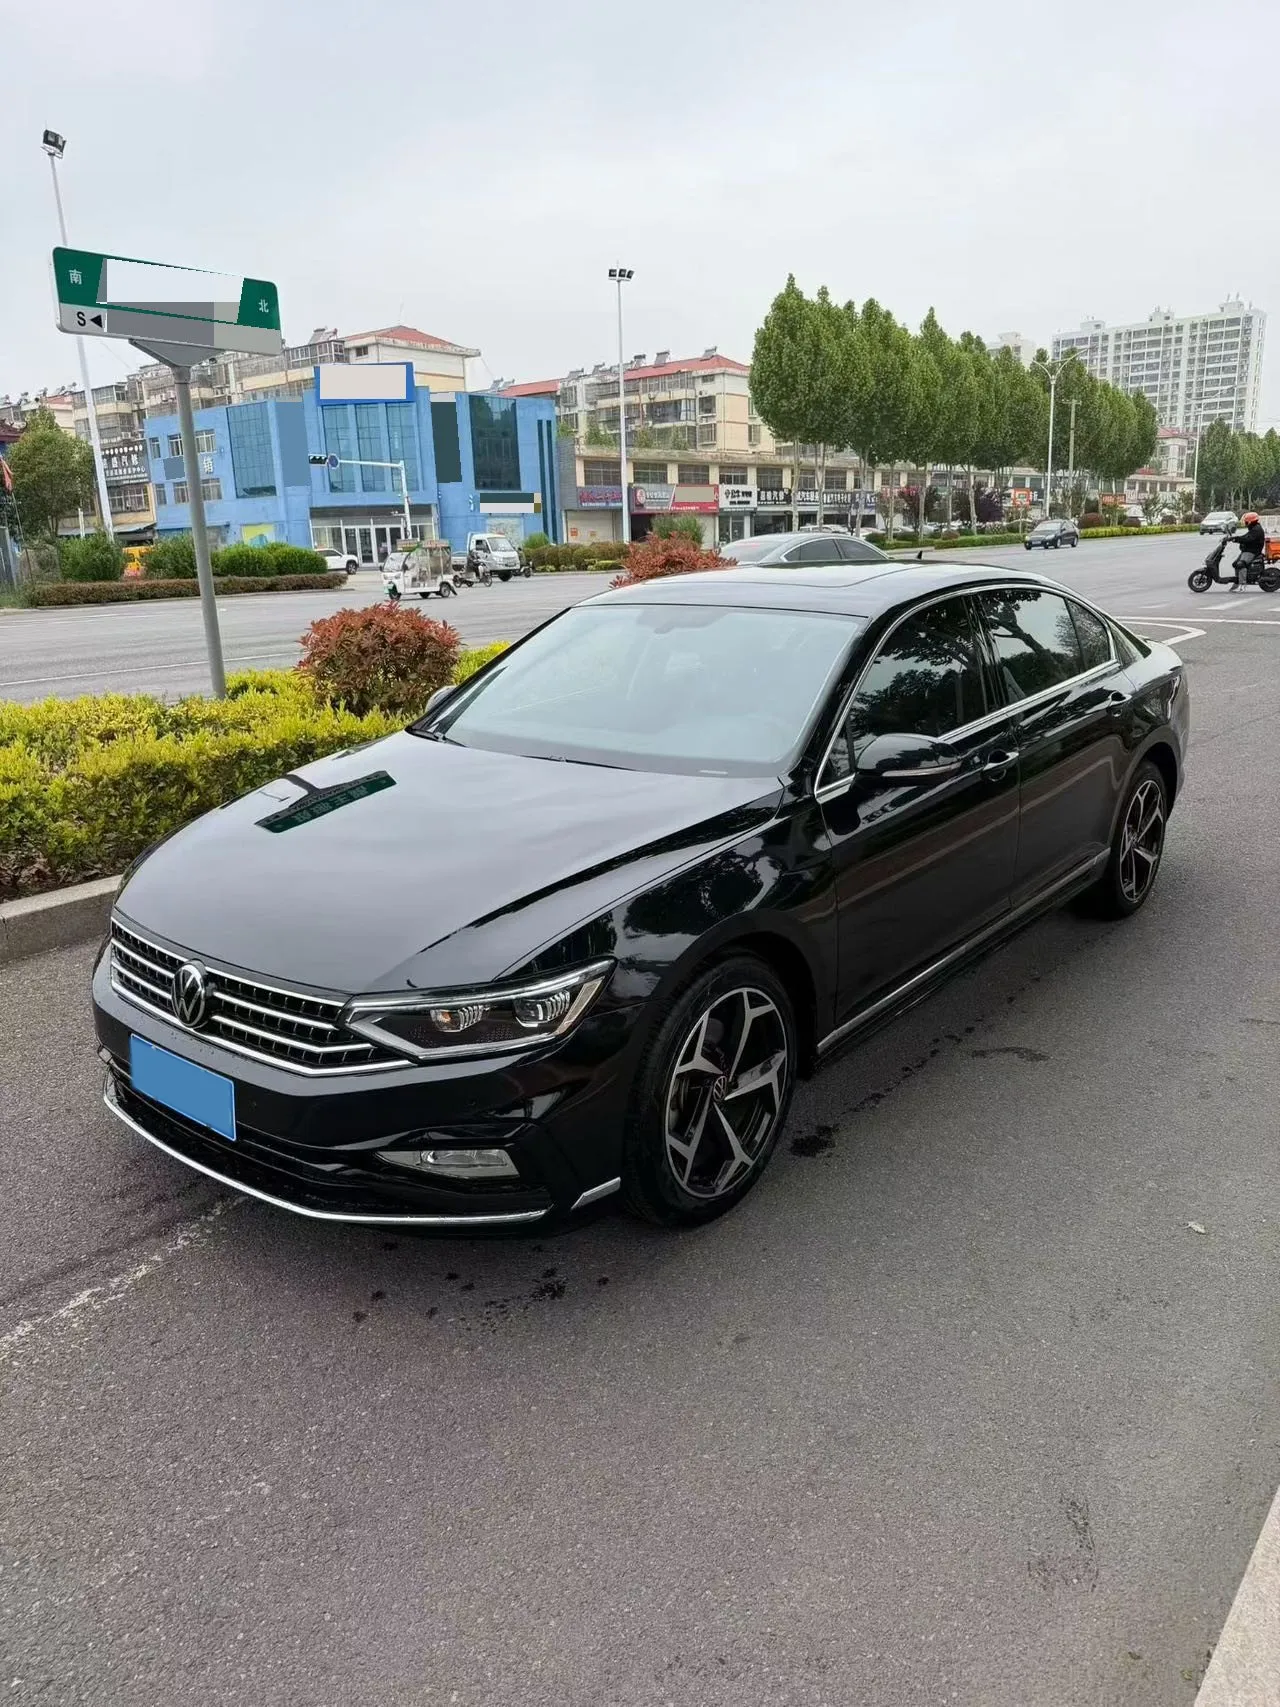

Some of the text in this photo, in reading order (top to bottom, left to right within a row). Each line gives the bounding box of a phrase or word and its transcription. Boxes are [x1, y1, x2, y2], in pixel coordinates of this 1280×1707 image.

[69, 268, 82, 285] 南
[258, 299, 269, 313] 北
[76, 311, 87, 327] S
